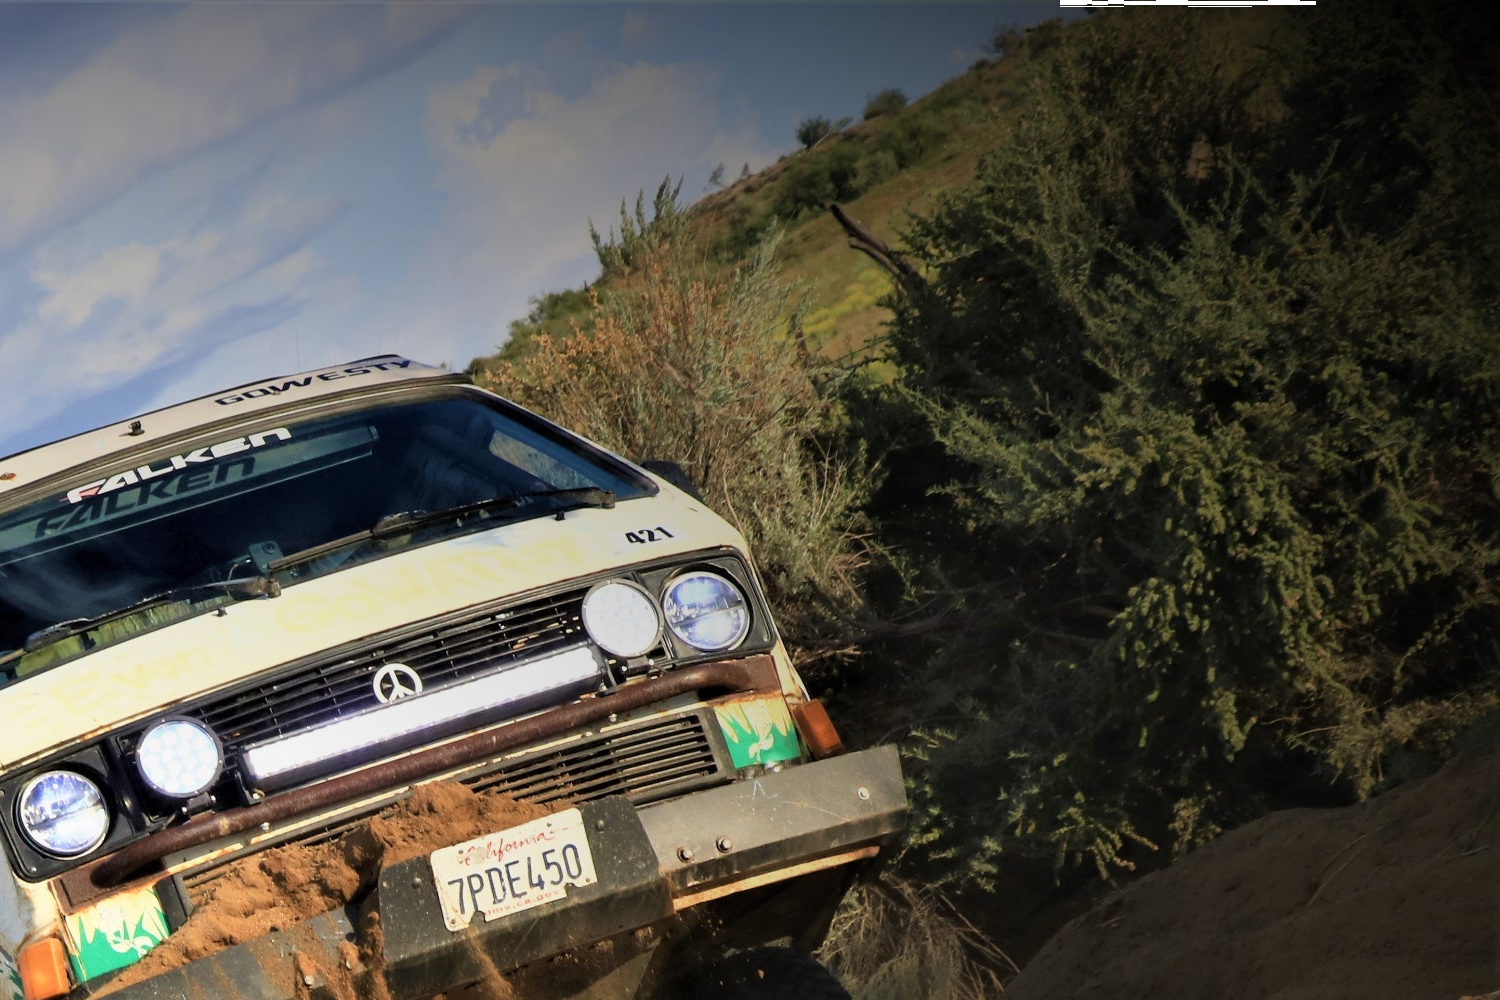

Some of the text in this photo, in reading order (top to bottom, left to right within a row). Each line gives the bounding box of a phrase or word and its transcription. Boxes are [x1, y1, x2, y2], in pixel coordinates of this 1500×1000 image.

[214, 360, 411, 406] GOWESTY
[63, 427, 292, 504] FALKEN
[625, 526, 674, 544] 421
[465, 831, 557, 866] Clifornia
[447, 843, 583, 915] 7PDE450
